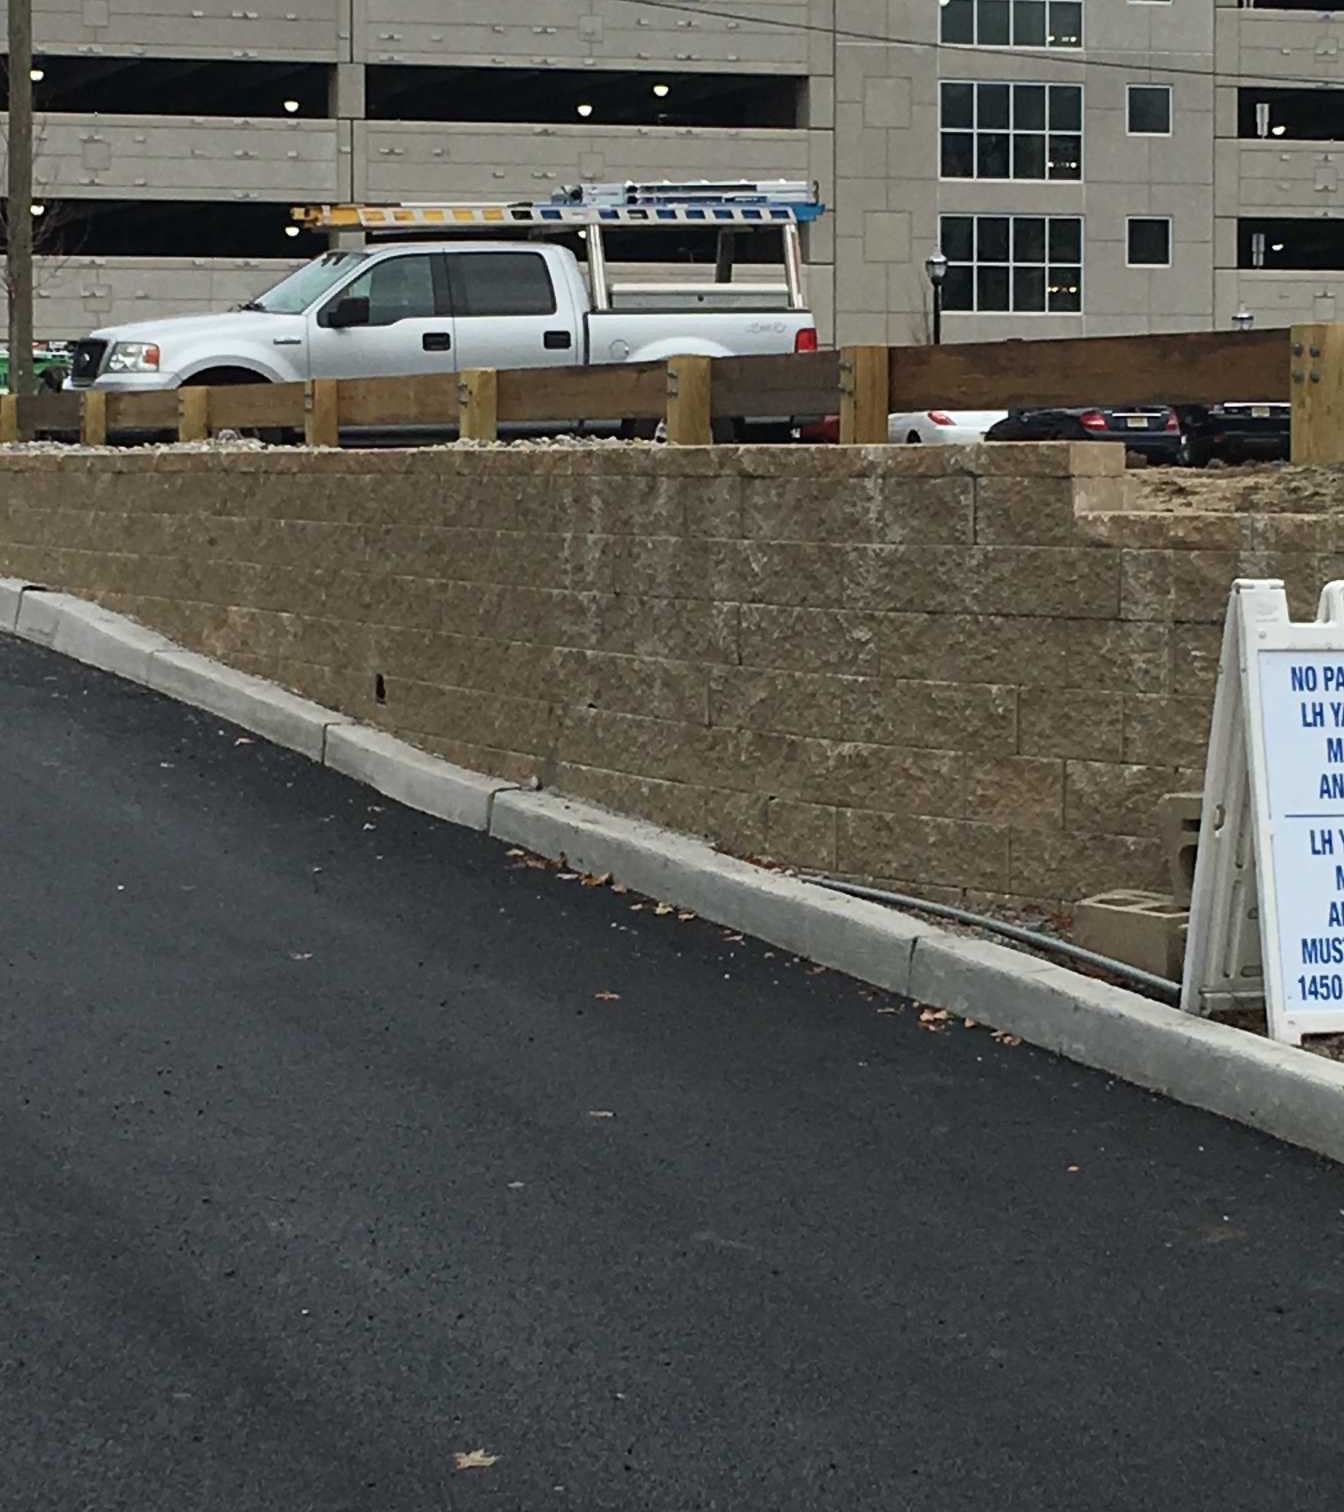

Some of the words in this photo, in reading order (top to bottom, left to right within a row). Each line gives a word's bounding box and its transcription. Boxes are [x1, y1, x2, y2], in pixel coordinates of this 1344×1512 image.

[1291, 666, 1317, 691] NO
[1301, 702, 1323, 727] LH
[1310, 830, 1333, 855] LH
[1298, 974, 1342, 1000] 1450
